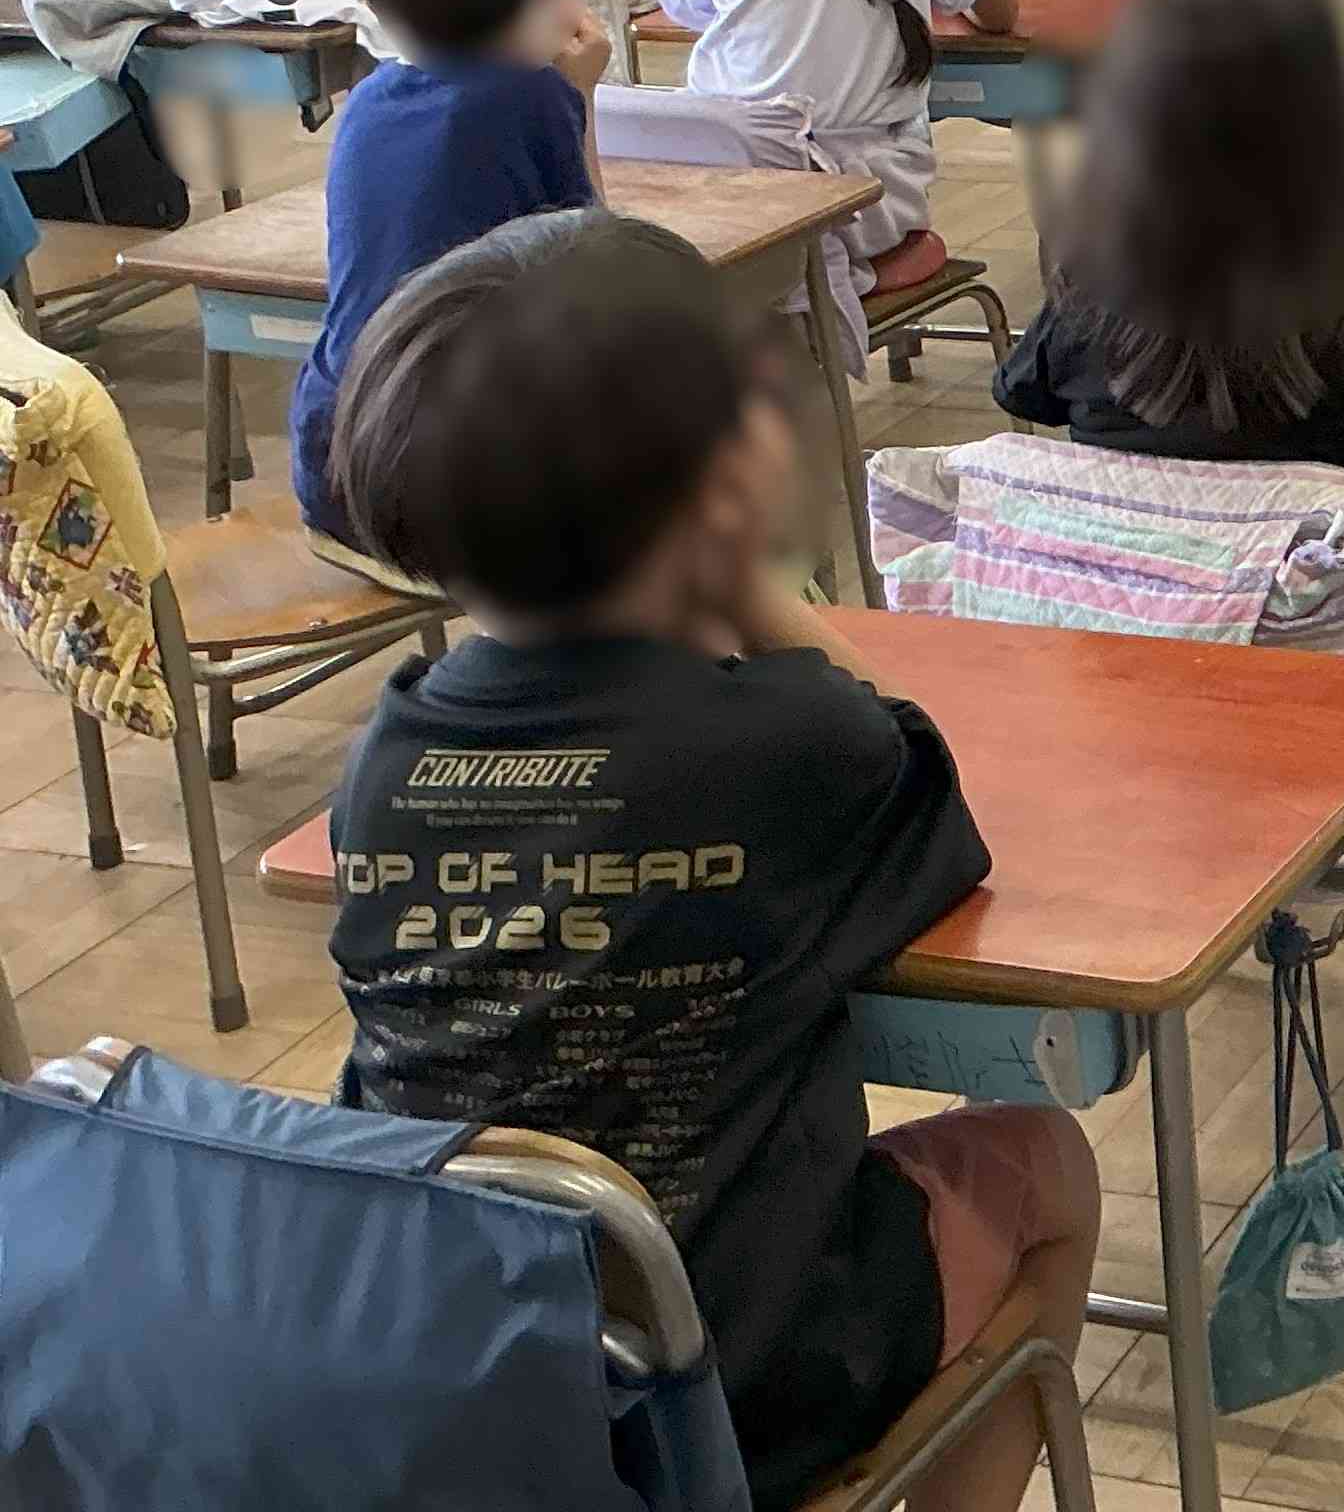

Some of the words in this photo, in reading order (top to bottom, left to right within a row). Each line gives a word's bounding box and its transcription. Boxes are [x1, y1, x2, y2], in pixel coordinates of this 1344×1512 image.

[408, 749, 611, 787] CONTRIBUTE
[438, 851, 518, 894] OF
[541, 843, 746, 896] HEAD
[395, 903, 612, 951] 2026
[453, 998, 524, 1017] GIRLS
[549, 1003, 637, 1020] BOYS
